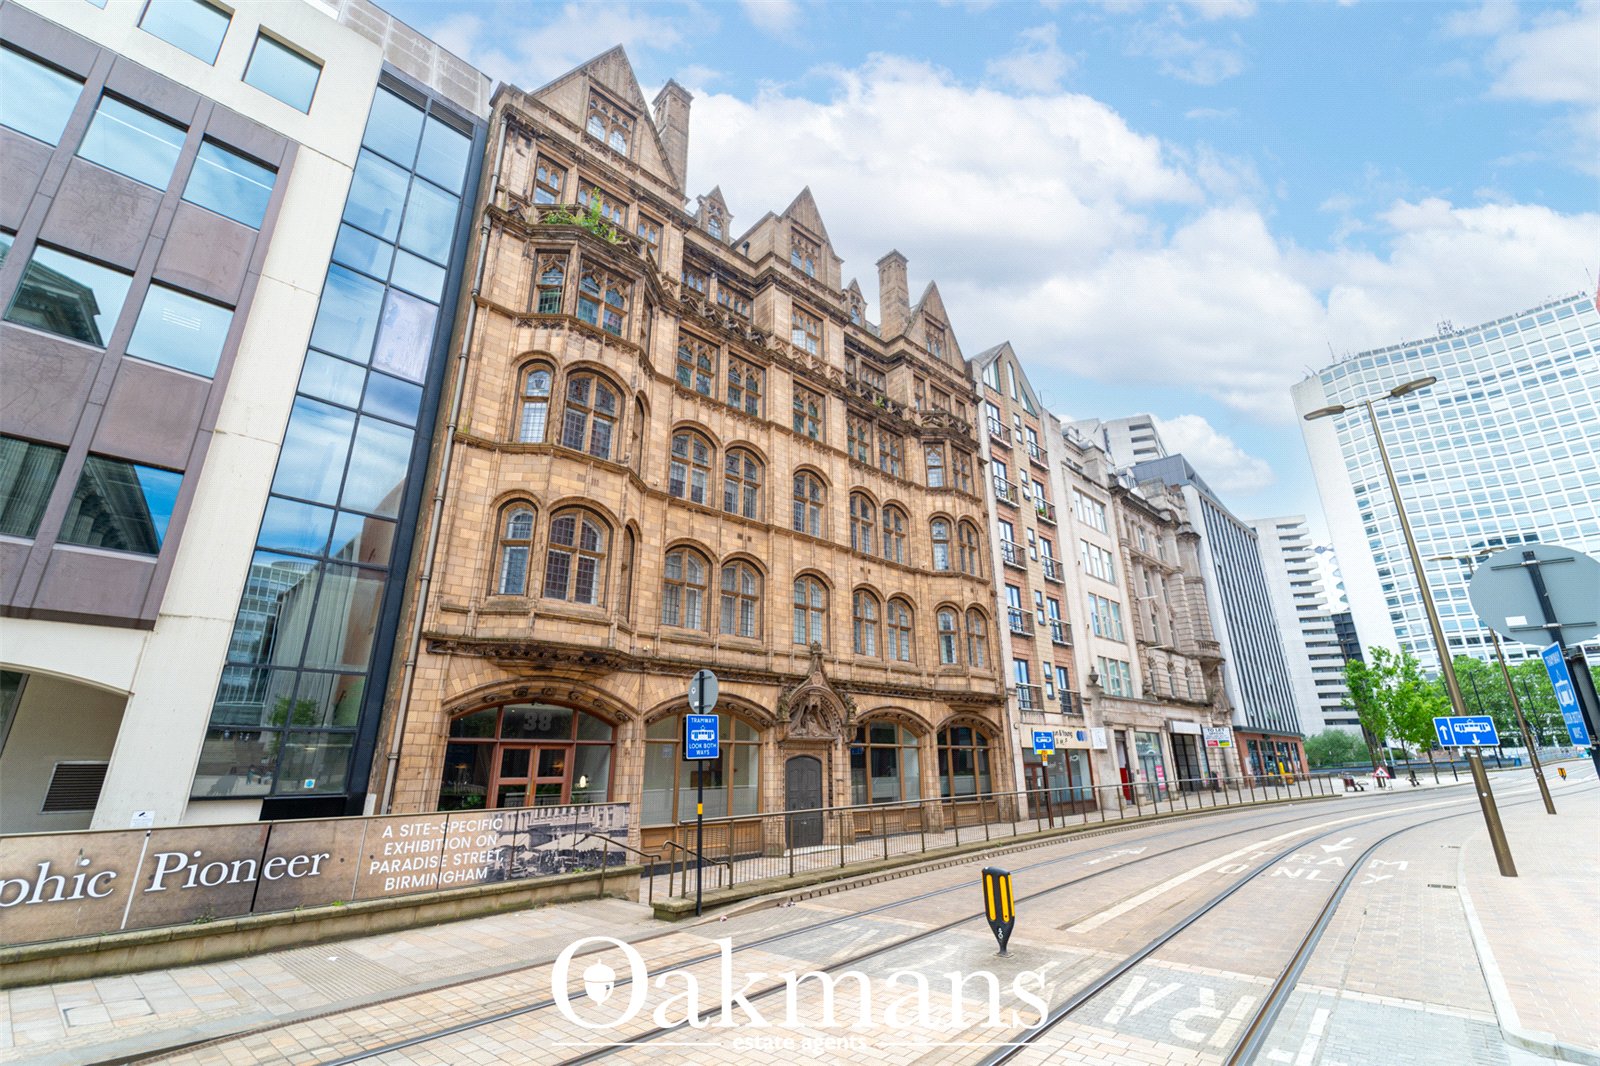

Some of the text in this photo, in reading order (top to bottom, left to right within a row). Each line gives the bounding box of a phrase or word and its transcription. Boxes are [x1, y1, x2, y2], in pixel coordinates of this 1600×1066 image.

[524, 712, 553, 732] 38
[382, 818, 503, 838] A SITE-SPECIFIC
[384, 835, 497, 856] EXHIBITION ON
[369, 849, 504, 875] PARADISE STREET,
[1247, 849, 1409, 871] TRAM
[144, 850, 330, 893] Pioneer
[384, 867, 488, 891] BIRMINGHAM
